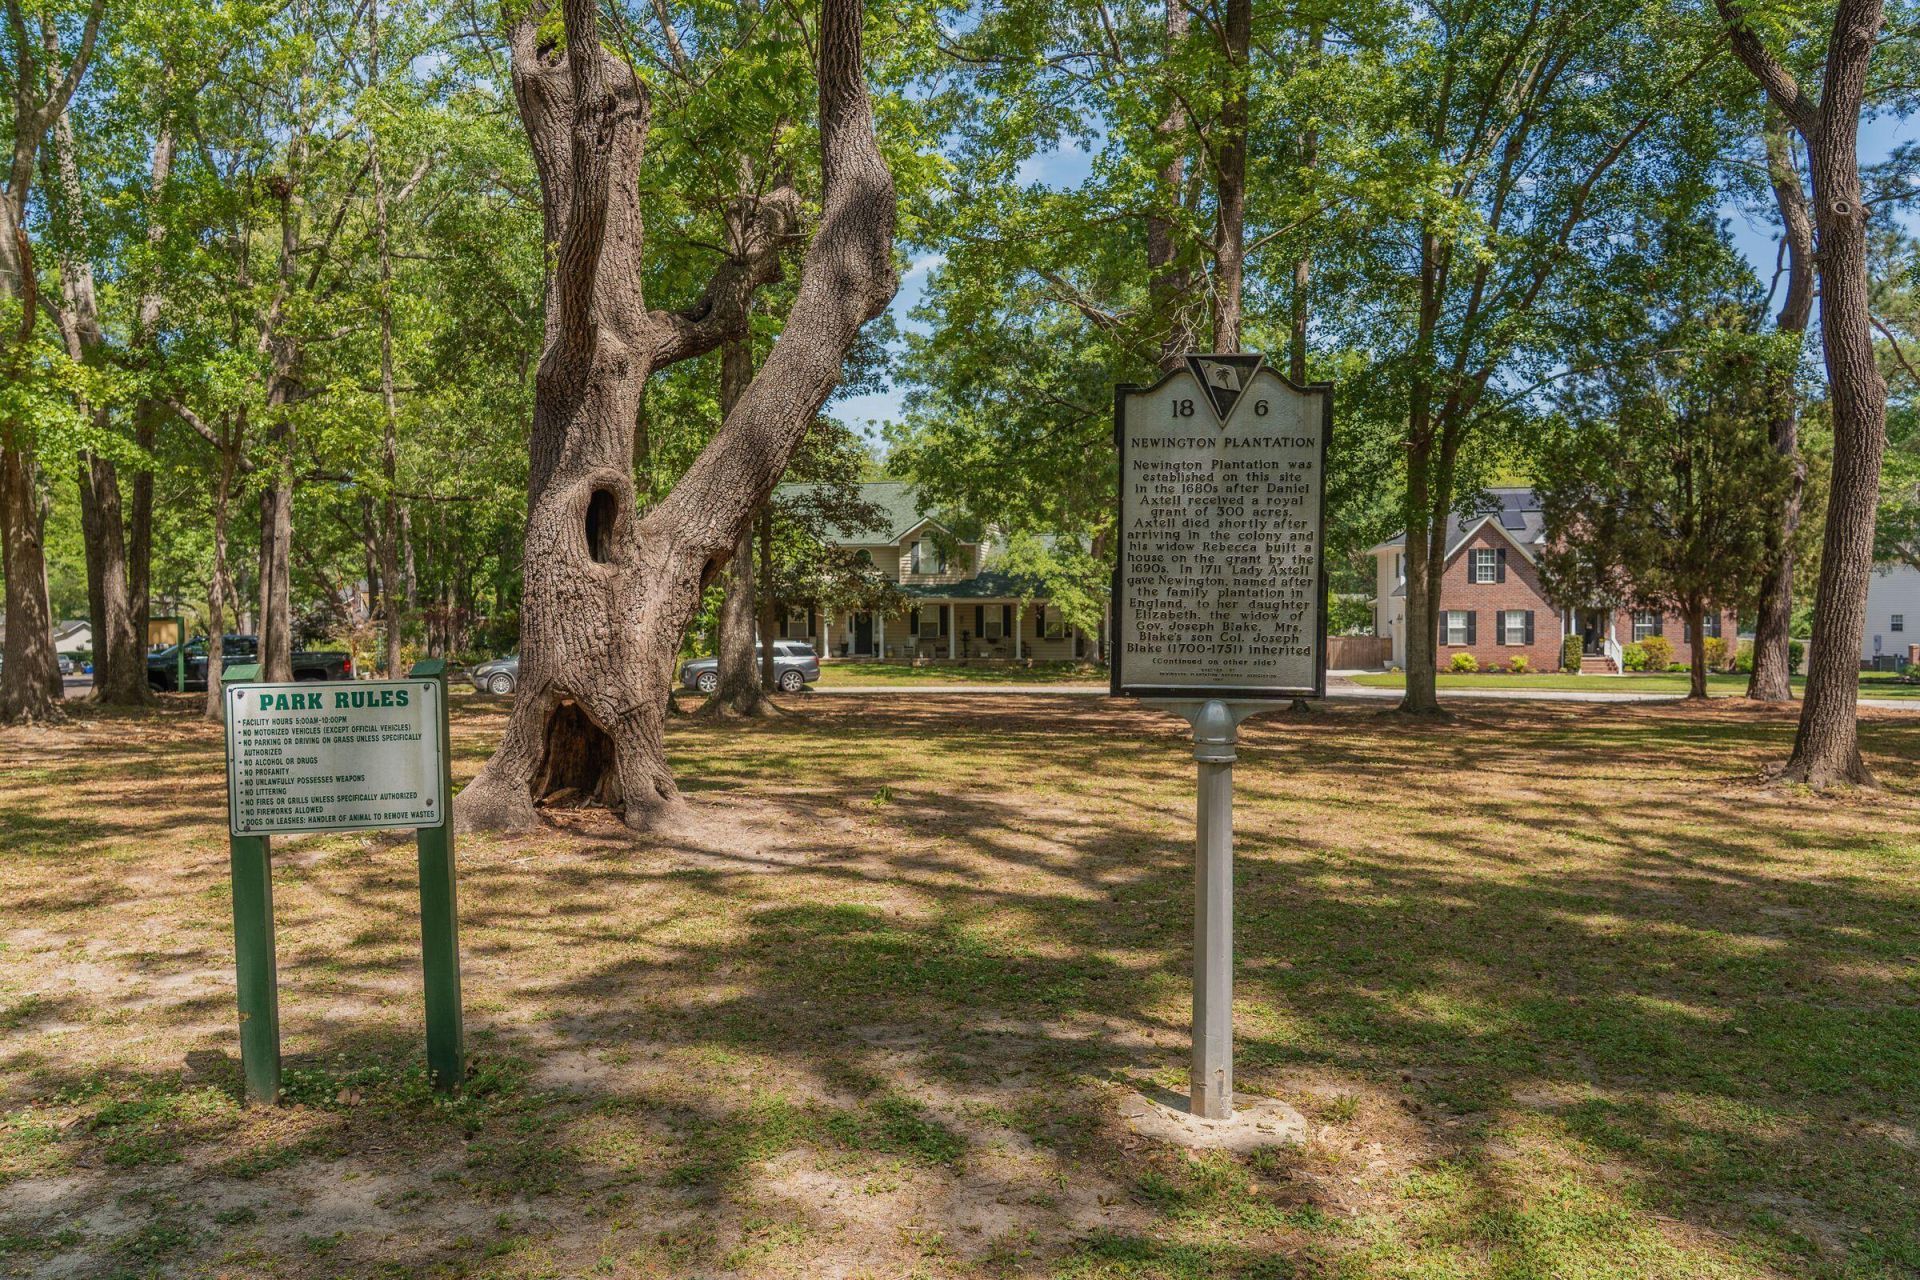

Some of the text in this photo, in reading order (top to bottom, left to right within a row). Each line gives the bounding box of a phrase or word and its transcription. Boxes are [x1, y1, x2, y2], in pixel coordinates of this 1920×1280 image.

[1172, 399, 1269, 417] 18 6
[1131, 438, 1316, 448] NEWINGTON PLANTATION
[1133, 460, 1202, 472] Newington
[1211, 460, 1279, 469] Plantation
[1142, 471, 1214, 481] established
[1247, 472, 1269, 481] this
[1279, 472, 1301, 481] site
[1135, 483, 1309, 493] in the 1680s after Daniel
[1140, 496, 1181, 505] Axtell
[1188, 496, 1244, 505] received
[1267, 496, 1303, 507] royal
[1151, 507, 1292, 518] grant of 300 acres.
[1135, 518, 1308, 530] Axtell died shortly after
[1127, 530, 1314, 542] arriving in the colony and
[1130, 542, 1312, 552] his widow Rebecca built a
[1127, 553, 1314, 566] house on the grant by the
[1131, 564, 1309, 576] 1690s. In 1711 Lady Axtell
[1127, 576, 1314, 587] gave Newington, named after
[1138, 587, 1303, 599] the family plantation in
[1198, 600, 1210, 609] to
[1217, 599, 1239, 609] her
[1249, 600, 1310, 611] daughter
[1210, 610, 1230, 620] the
[1241, 611, 1280, 620] widow
[1290, 611, 1304, 621] of
[1136, 621, 1163, 631] Gov.
[1169, 622, 1214, 633] Joseph
[1275, 623, 1302, 632] Mrs.
[1139, 632, 1299, 645] Blake's son Col. Joseph
[1127, 643, 1311, 655] Blake (1700-1751) inherited
[1153, 657, 1202, 665] (Continued
[260, 690, 409, 711] PARK RULES
[272, 717, 293, 725] HOURS
[254, 728, 289, 736] MOTORIZED
[292, 726, 321, 734] VEHICLES
[324, 725, 349, 734] (EXCEPT
[352, 725, 377, 733] OFFICIAL
[254, 738, 281, 746] PARKING
[295, 736, 320, 744] DRIVING
[334, 735, 354, 743] GRASS
[357, 734, 380, 742] UNLESS
[382, 733, 422, 741] SPECIFICALLY
[244, 748, 282, 756] AUTHORIZED
[244, 758, 252, 766] NO
[244, 767, 289, 776] NO PROFANITY
[256, 777, 294, 786] UNLAWFULLY
[297, 776, 333, 784] POSSESSES
[256, 798, 274, 806] FIRES
[287, 796, 308, 804] GRILLS
[311, 795, 334, 803] UNLESS
[337, 793, 377, 802] SPECIFICALLY
[380, 792, 417, 800] AUTHORIZED
[257, 807, 292, 816] FIREWORKS
[295, 806, 323, 814] ALLOWED
[246, 818, 263, 826] DOGS
[277, 816, 306, 825] LEASHES:
[308, 815, 336, 823] HANDLER
[339, 814, 347, 822] OF
[349, 813, 371, 821] ANIMAL
[374, 813, 382, 821] TO
[384, 812, 408, 820] REMOVE
[410, 811, 434, 819] WASTES
